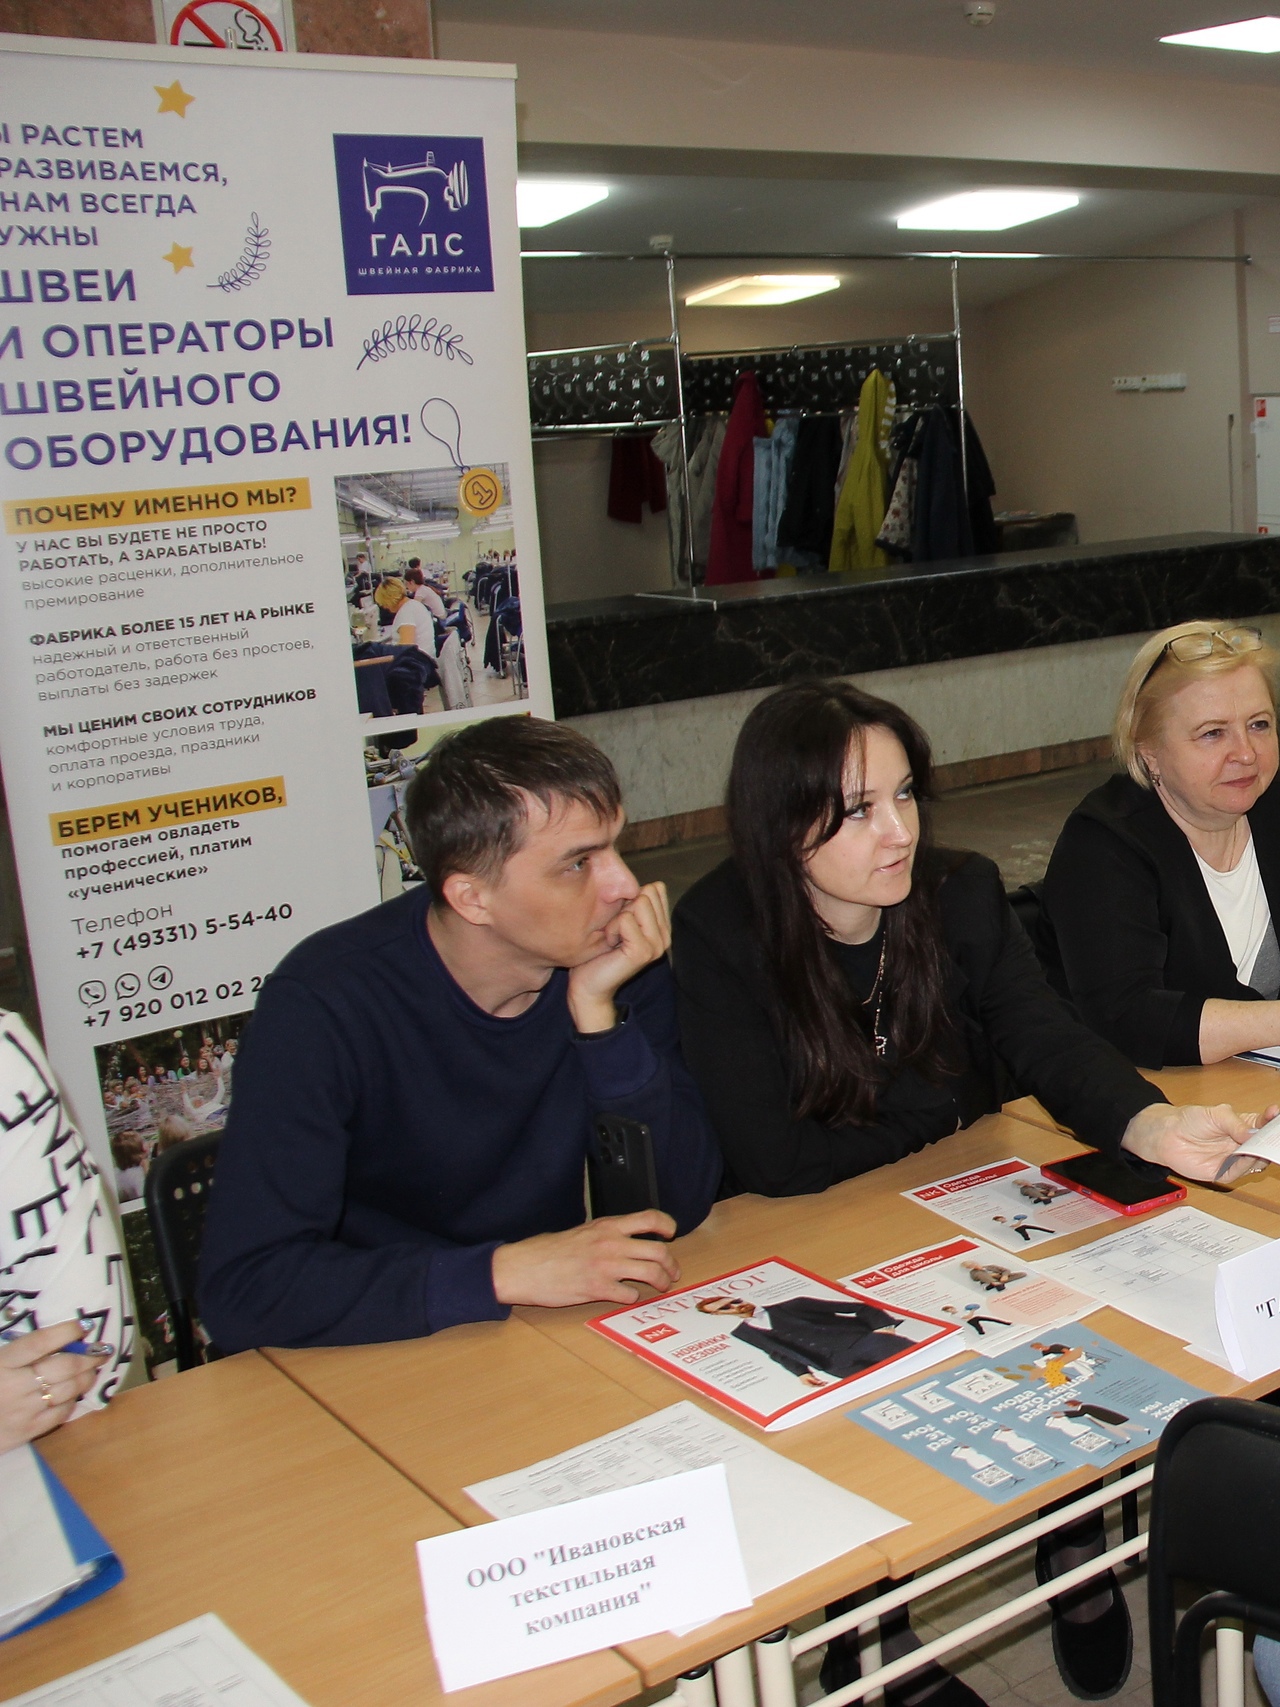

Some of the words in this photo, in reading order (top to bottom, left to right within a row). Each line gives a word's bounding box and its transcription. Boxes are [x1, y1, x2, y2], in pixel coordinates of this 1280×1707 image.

[21, 123, 144, 149] РАСТЕМ
[0, 157, 228, 187] РАЗВИВАЕМСЯ,
[0, 191, 70, 213] НАМ
[80, 192, 197, 218] ВСЕГДА
[0, 225, 98, 246] УЖНЫ
[370, 233, 464, 257] ГАЛС
[0, 268, 136, 303] ШВЕИ
[358, 266, 419, 275] ШВЕЙНАЯ
[425, 265, 481, 274] ФАБРИКА
[42, 317, 334, 359] ОПЕРАТОРЫ
[0, 368, 280, 415] ШВЕЙНОГО
[5, 413, 413, 471] ОБОРУДОВАНИЯ!
[15, 501, 125, 527] ПОЧЕМУ
[135, 491, 239, 516] ИМЕННО
[247, 486, 297, 507] МЫ?
[16, 541, 28, 553] У
[34, 538, 70, 552] НАС
[77, 535, 103, 549] ВЫ
[108, 529, 171, 548] БУДЕТЕ
[176, 526, 197, 540] НЕ
[202, 520, 267, 537] ПРОСТО
[19, 553, 114, 572] РАБОТАТЬ,
[118, 551, 130, 563] А
[135, 538, 267, 561] ЗАРАБАТЫВАТЬ!
[22, 574, 93, 591] высокие
[98, 565, 177, 586] расценки,
[180, 552, 305, 577] дополнительное
[25, 587, 145, 611] премирование
[29, 625, 115, 647] ФАБРИКА
[121, 618, 176, 636] БОЛЕЕ
[179, 616, 195, 629] 15
[199, 612, 230, 627] ЛЕТ
[234, 609, 256, 622] НА
[260, 602, 315, 620] РЫНКЕ
[33, 643, 117, 666] надежный
[121, 644, 131, 655] и
[135, 627, 250, 653] ответственный
[35, 661, 150, 684] работодатель,
[154, 651, 208, 670] работа
[212, 646, 238, 660] без
[242, 638, 315, 659] простоев,
[38, 682, 110, 702] выплаты
[114, 677, 140, 691] без
[144, 668, 219, 689] задержек
[43, 724, 74, 738] МЫ
[78, 713, 138, 735] ЦЕНИМ
[141, 704, 198, 724] СВОИХ
[202, 688, 317, 716] СОТРУДНИКОВ
[46, 731, 148, 756] комфортные
[152, 722, 215, 743] условия
[219, 714, 265, 734] труда,
[49, 756, 106, 775] оплата
[110, 747, 177, 768] проезда,
[181, 733, 260, 757] праздники
[51, 781, 62, 792] и
[66, 763, 172, 791] корпоративы
[58, 809, 141, 838] БЕРЕМ
[147, 786, 283, 823] УЧЕНИКОВ,
[61, 832, 152, 859] помогаем
[158, 817, 240, 842] овладеть
[64, 846, 185, 880] профессией,
[190, 836, 253, 857] платим
[68, 864, 208, 900] «ученические»
[71, 904, 173, 935] Телефон
[76, 942, 103, 959] +7
[113, 922, 198, 956] (49331)
[206, 902, 293, 935] 5-54-40
[83, 1009, 111, 1028] +7
[120, 998, 162, 1022] 920
[170, 988, 209, 1010] 012
[215, 980, 244, 1000] 02
[942, 1172, 981, 1190] Одежда
[858, 1274, 883, 1287] NK
[883, 1255, 925, 1274] Одежда
[891, 1266, 910, 1277] для
[911, 1254, 944, 1271] школы
[644, 1327, 673, 1340] NK
[672, 1333, 731, 1359] НОВИНКИ
[682, 1343, 731, 1365] СЕЗОНА
[467, 1556, 527, 1590] ООО
[533, 1513, 686, 1568] "Ивановская
[510, 1554, 657, 1609] текстильная
[524, 1582, 652, 1637] компания"
